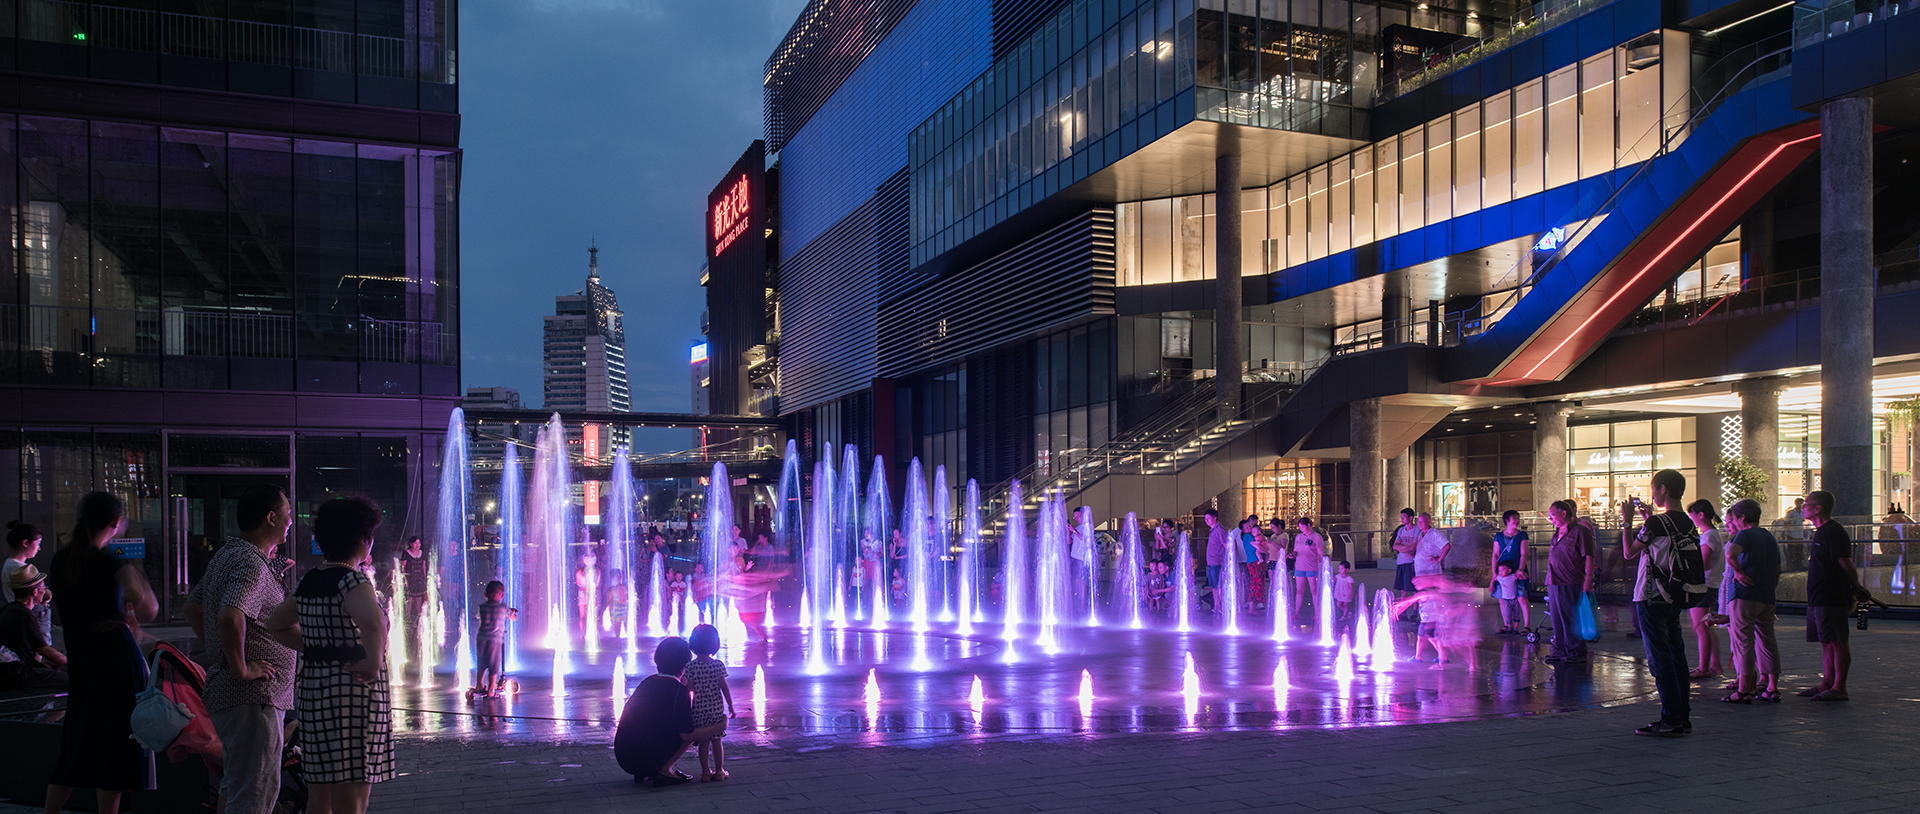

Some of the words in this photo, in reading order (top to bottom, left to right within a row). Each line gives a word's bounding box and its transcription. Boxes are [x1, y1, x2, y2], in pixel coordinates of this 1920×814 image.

[714, 174, 748, 240] 新光天地
[736, 216, 748, 237] PLACE
